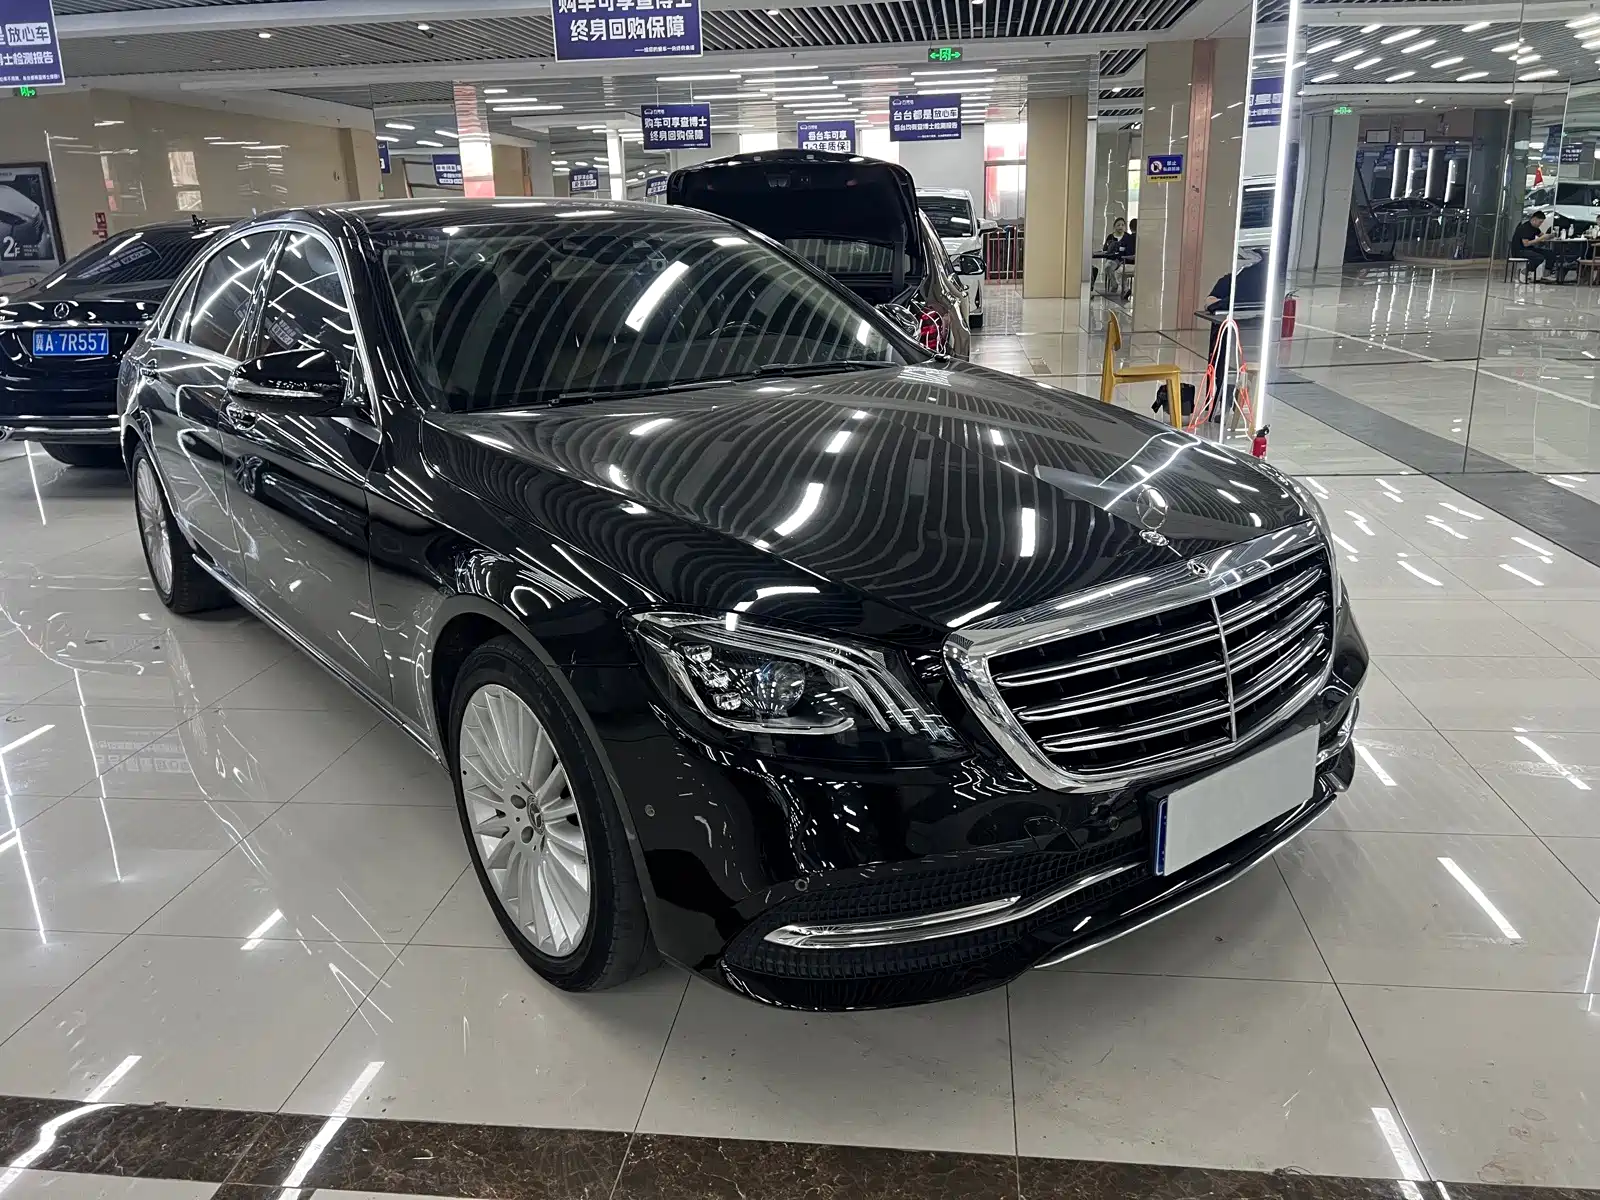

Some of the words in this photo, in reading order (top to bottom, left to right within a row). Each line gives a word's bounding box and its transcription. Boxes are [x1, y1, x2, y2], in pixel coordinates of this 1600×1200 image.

[569, 14, 685, 42] 终身回购保障
[644, 116, 707, 128] 购车可享查博士
[649, 129, 704, 141] 终身回购保障
